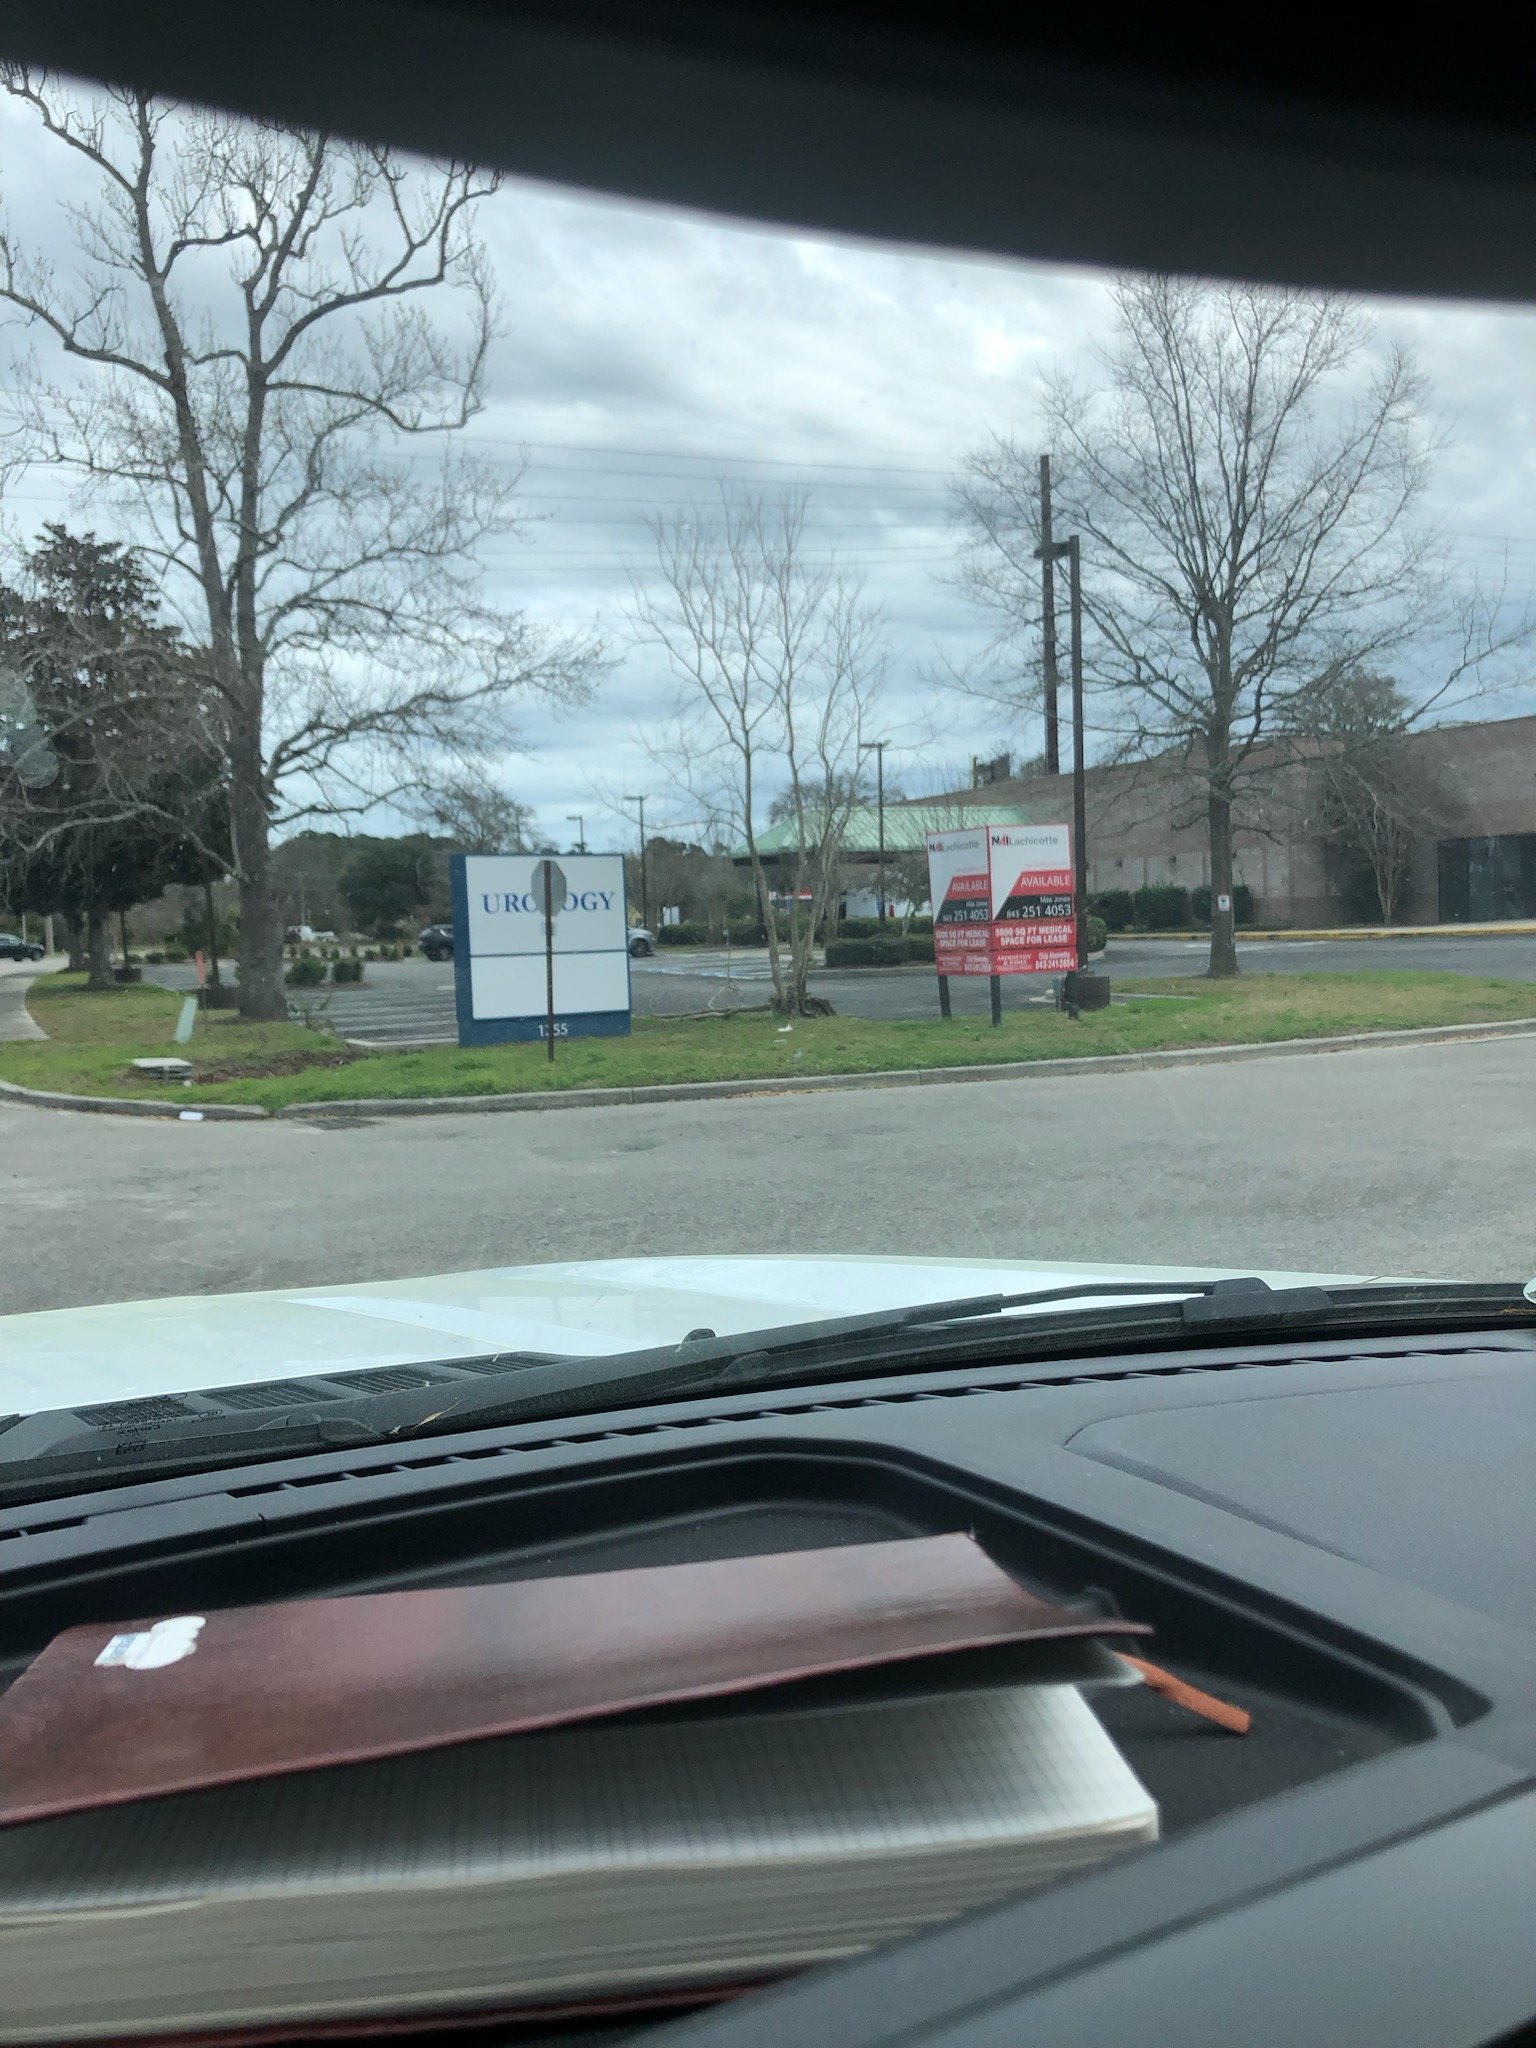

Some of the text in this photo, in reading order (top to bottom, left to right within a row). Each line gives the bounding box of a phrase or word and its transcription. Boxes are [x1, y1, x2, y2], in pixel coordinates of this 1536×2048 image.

[952, 880, 988, 892] AVAILABLE
[1021, 875, 1070, 888] AVAILABLE
[481, 889, 615, 914] UROOGY
[954, 910, 967, 922] 251
[970, 909, 989, 921] 4053
[1007, 904, 1071, 918] 843 251 4053
[1015, 927, 1026, 936] SQ
[1028, 926, 1037, 935] FT
[1039, 925, 1073, 934] MEDICAL
[1001, 934, 1068, 946] SPACE FOR LEASE
